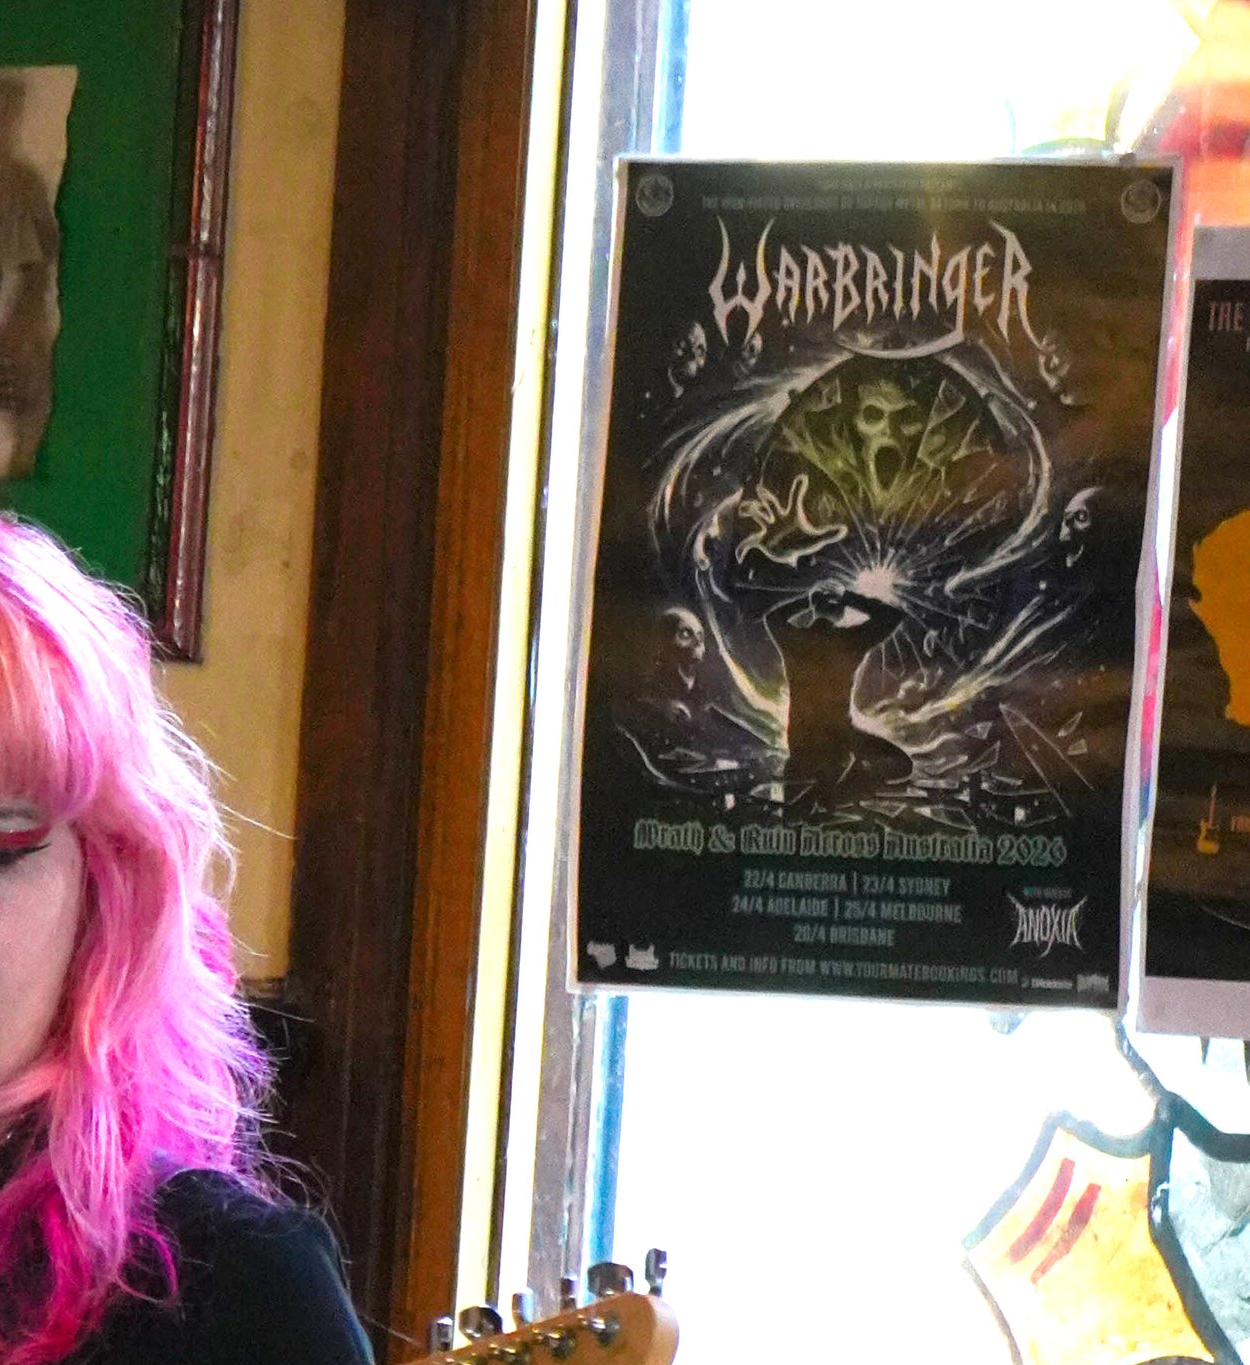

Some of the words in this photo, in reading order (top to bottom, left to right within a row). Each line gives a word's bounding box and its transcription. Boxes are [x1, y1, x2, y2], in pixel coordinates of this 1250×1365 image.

[709, 215, 1046, 358] WARBRINGER
[997, 833, 1067, 868] 2026
[778, 871, 847, 892] CANBERRA
[900, 877, 950, 896] SYDNEY
[767, 897, 828, 918] ADELAIDE
[880, 902, 962, 924] MELBOURNE
[1007, 892, 1088, 958] ANOXIA
